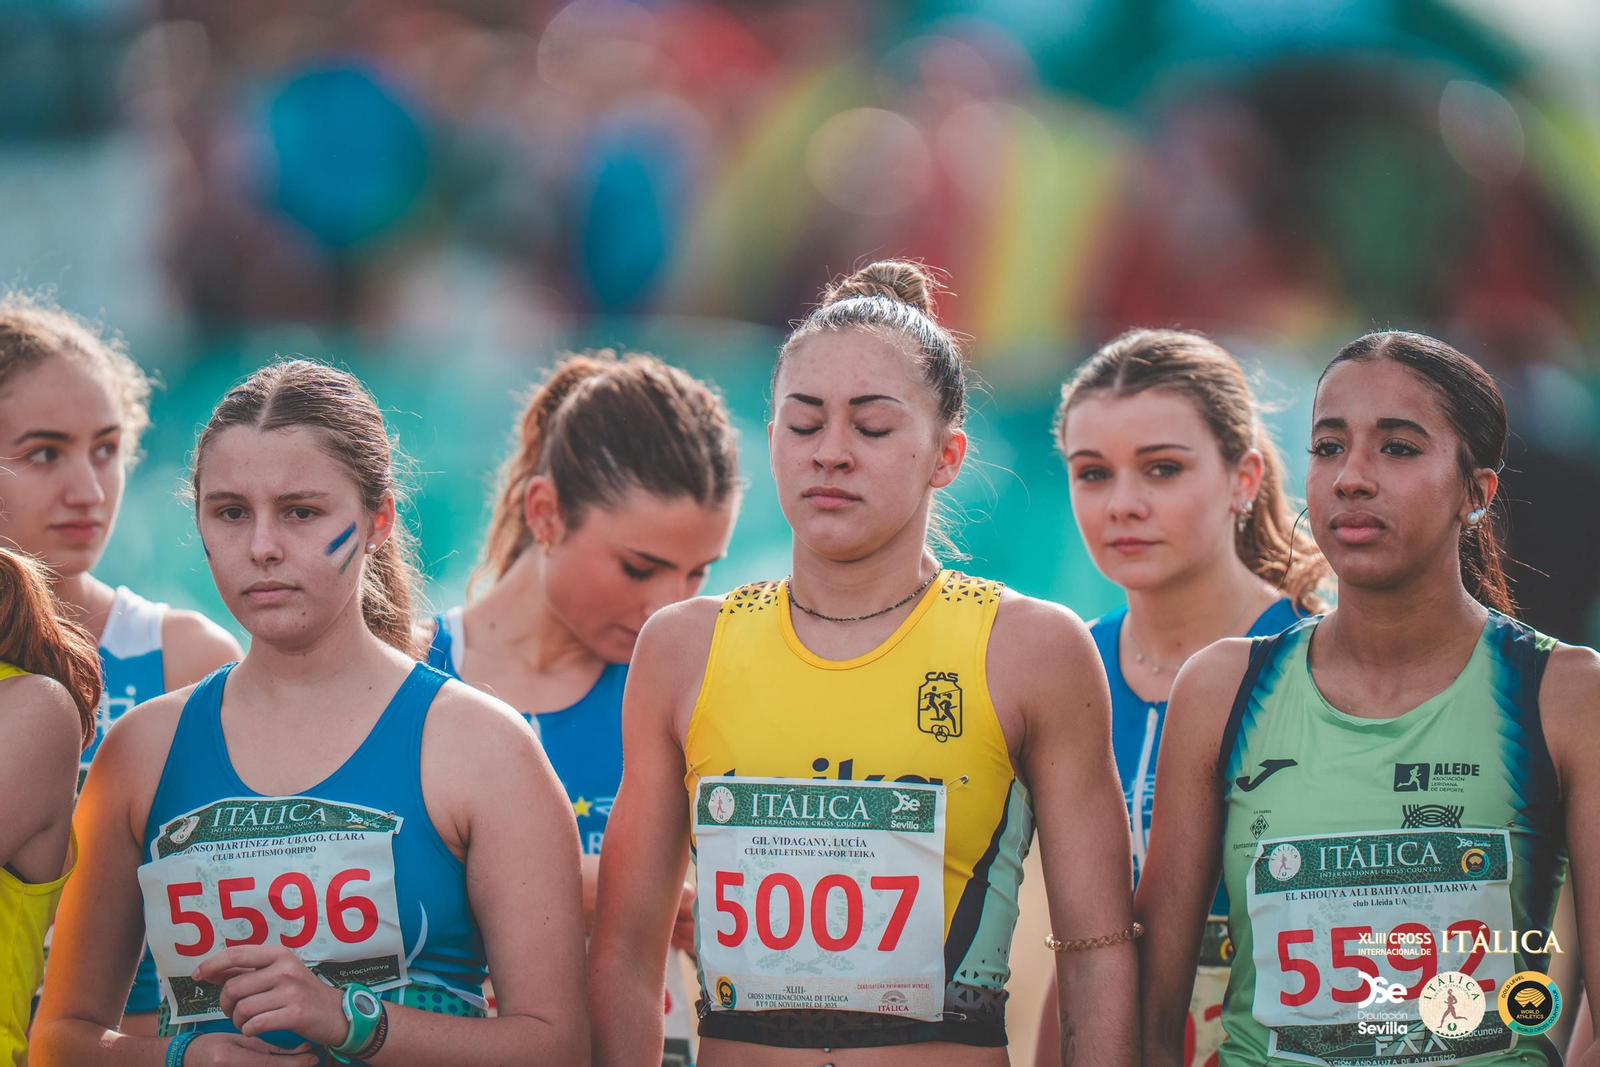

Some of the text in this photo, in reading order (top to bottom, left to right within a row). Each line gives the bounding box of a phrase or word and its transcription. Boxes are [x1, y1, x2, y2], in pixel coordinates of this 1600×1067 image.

[925, 671, 959, 684] CAS
[1434, 762, 1480, 777] ALEDE
[751, 788, 871, 820] ITÁLICA
[212, 802, 328, 827] ITÁLICA
[211, 825, 268, 834] INTERNATIONAL
[751, 819, 810, 827] INTERNATIONAL
[890, 820, 920, 830] Sevilla
[216, 838, 269, 852] MARTÍNEZ
[271, 838, 286, 846] DE
[287, 834, 327, 845] UBAGO,
[328, 832, 366, 842] CLARA
[752, 836, 868, 848] GIL VIDAGANY, LUCÍA
[212, 845, 317, 862] CLUB ATLETISMO ORIPPO
[744, 848, 876, 858] CLUB ATLETISME SAFOR TEIKA
[1318, 838, 1442, 871] ITÁLICA
[1319, 868, 1380, 878] INTERNATIONAL
[1406, 866, 1442, 874] COUNTRY
[1285, 883, 1478, 902] EL KHOUYA ALI BAHYAOUI, MARWA
[1352, 900, 1369, 908] club
[1370, 898, 1394, 907] Lleida
[166, 868, 379, 957] 5596
[715, 870, 920, 953] 5007
[348, 964, 390, 975] docunova
[1277, 918, 1496, 1008] 5592
[824, 994, 848, 1002] ITÁLICA
[878, 1003, 910, 1012] ITÁLICA
[1354, 1059, 1398, 1067] ANDALUZA
[1414, 1053, 1456, 1064] ATLETISMO
